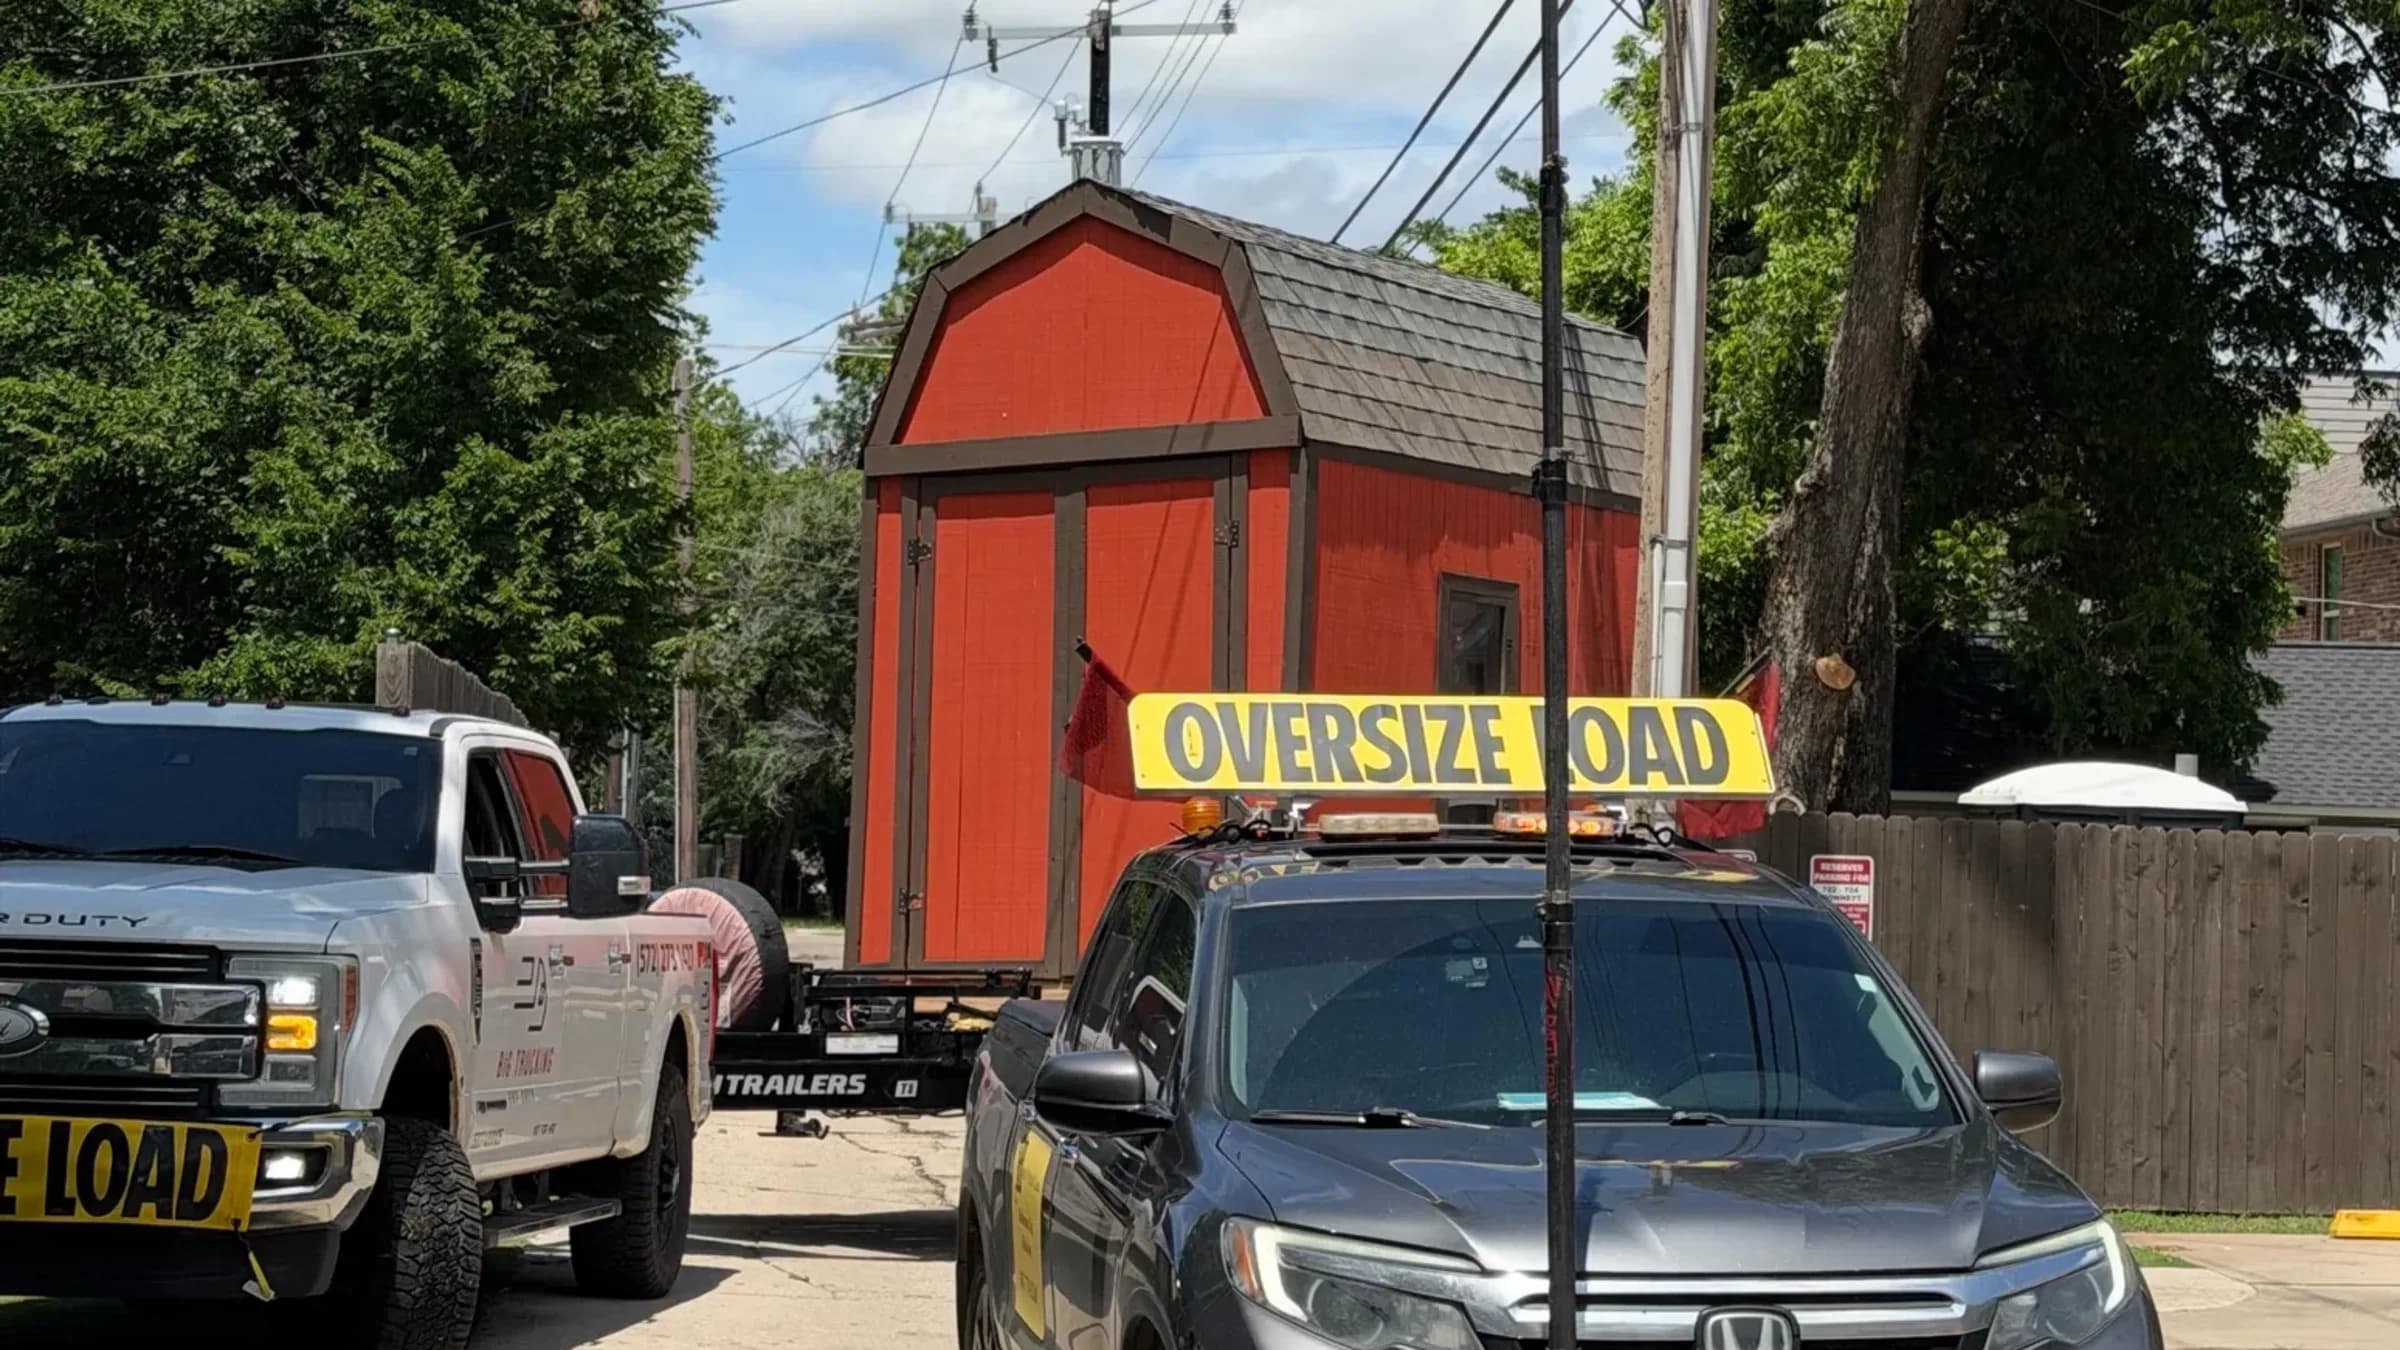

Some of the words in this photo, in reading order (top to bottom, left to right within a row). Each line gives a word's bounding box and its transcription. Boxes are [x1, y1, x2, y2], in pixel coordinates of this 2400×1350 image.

[1164, 702, 1512, 784] OVERSIZE
[1820, 863, 1864, 871] RESERVED
[1815, 873, 1850, 882] PARKING
[1853, 873, 1869, 882] FOR
[23, 912, 149, 928] DUTY
[726, 1074, 867, 1096] TRAILERS
[45, 1120, 229, 1222] LOAD
